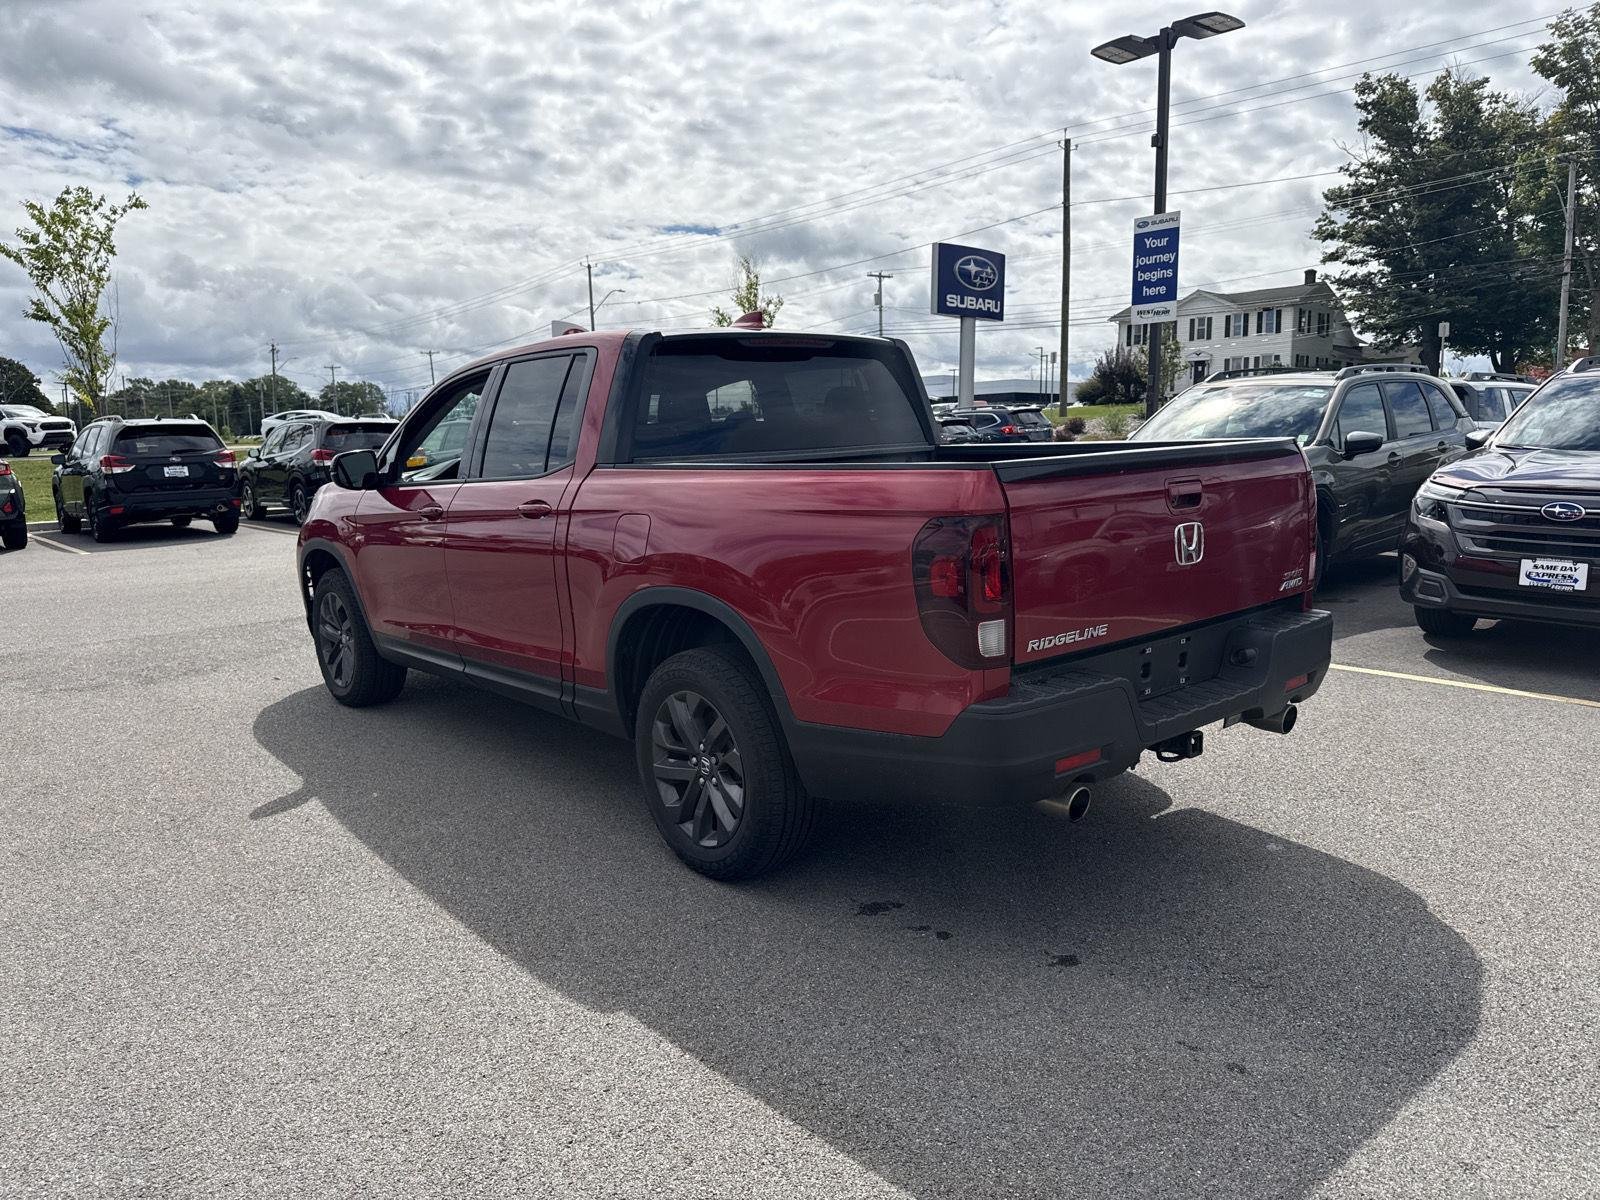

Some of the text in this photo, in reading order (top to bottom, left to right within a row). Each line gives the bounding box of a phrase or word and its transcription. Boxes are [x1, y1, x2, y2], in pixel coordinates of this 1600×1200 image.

[1150, 216, 1179, 226] SUBARU
[1144, 236, 1169, 249] Your
[1135, 252, 1176, 268] journey
[1137, 268, 1173, 282] begins
[1142, 285, 1167, 297] here
[945, 294, 1001, 313] SUBARU
[1528, 571, 1574, 580] EXPRESS
[1026, 623, 1109, 653] RIDGELINE
